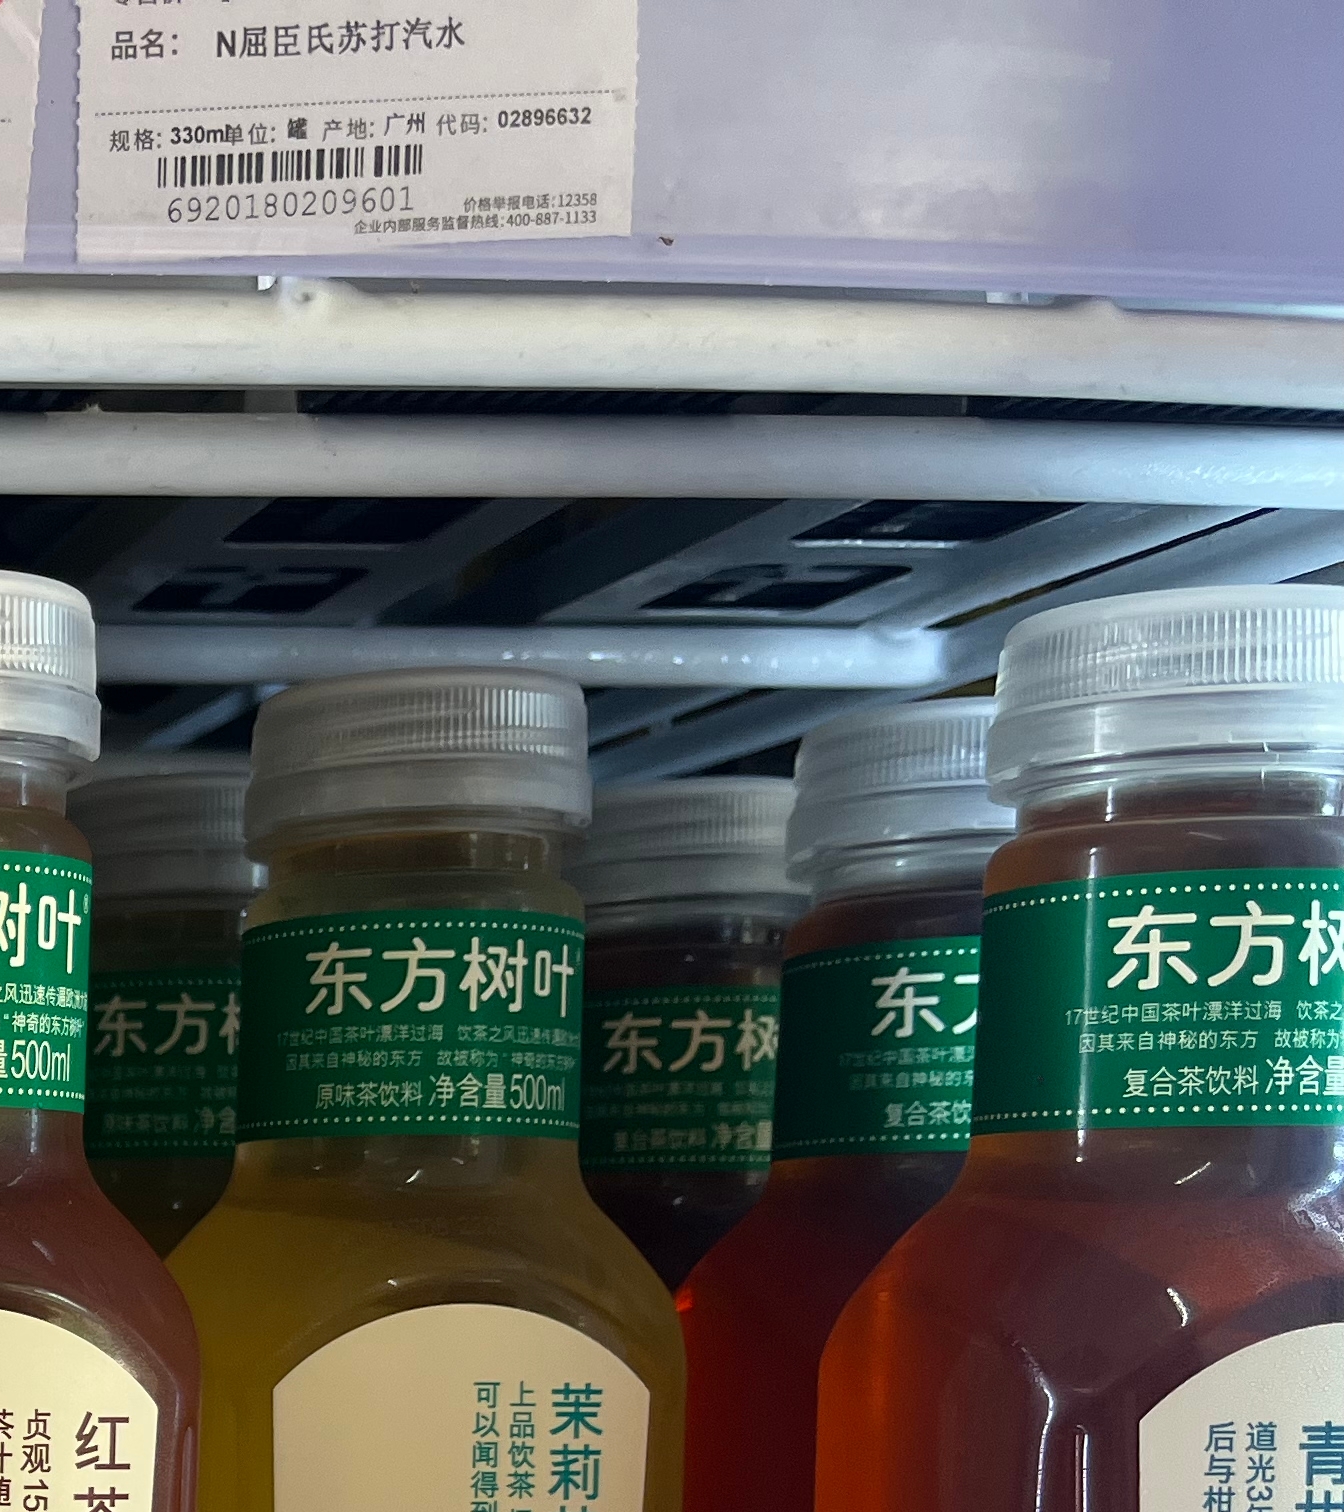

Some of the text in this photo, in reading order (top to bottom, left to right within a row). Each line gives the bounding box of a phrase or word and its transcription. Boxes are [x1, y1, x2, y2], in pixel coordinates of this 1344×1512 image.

[216, 18, 465, 59] N屈臣氏苏打汽水
[384, 113, 426, 136] 广州
[497, 107, 592, 129] 02896632
[167, 186, 414, 223] 6920180209601
[305, 936, 575, 1018] 东方树叶
[1065, 1001, 1281, 1026] 17世纪中国茶叶漂洋过海
[1078, 1030, 1258, 1054] 因其来自神秘的东方
[315, 1073, 565, 1112] 原味茶饮料 净含量500ml
[1123, 1066, 1259, 1098] 复合茶饮料
[507, 1381, 536, 1499] 上品饮茶
